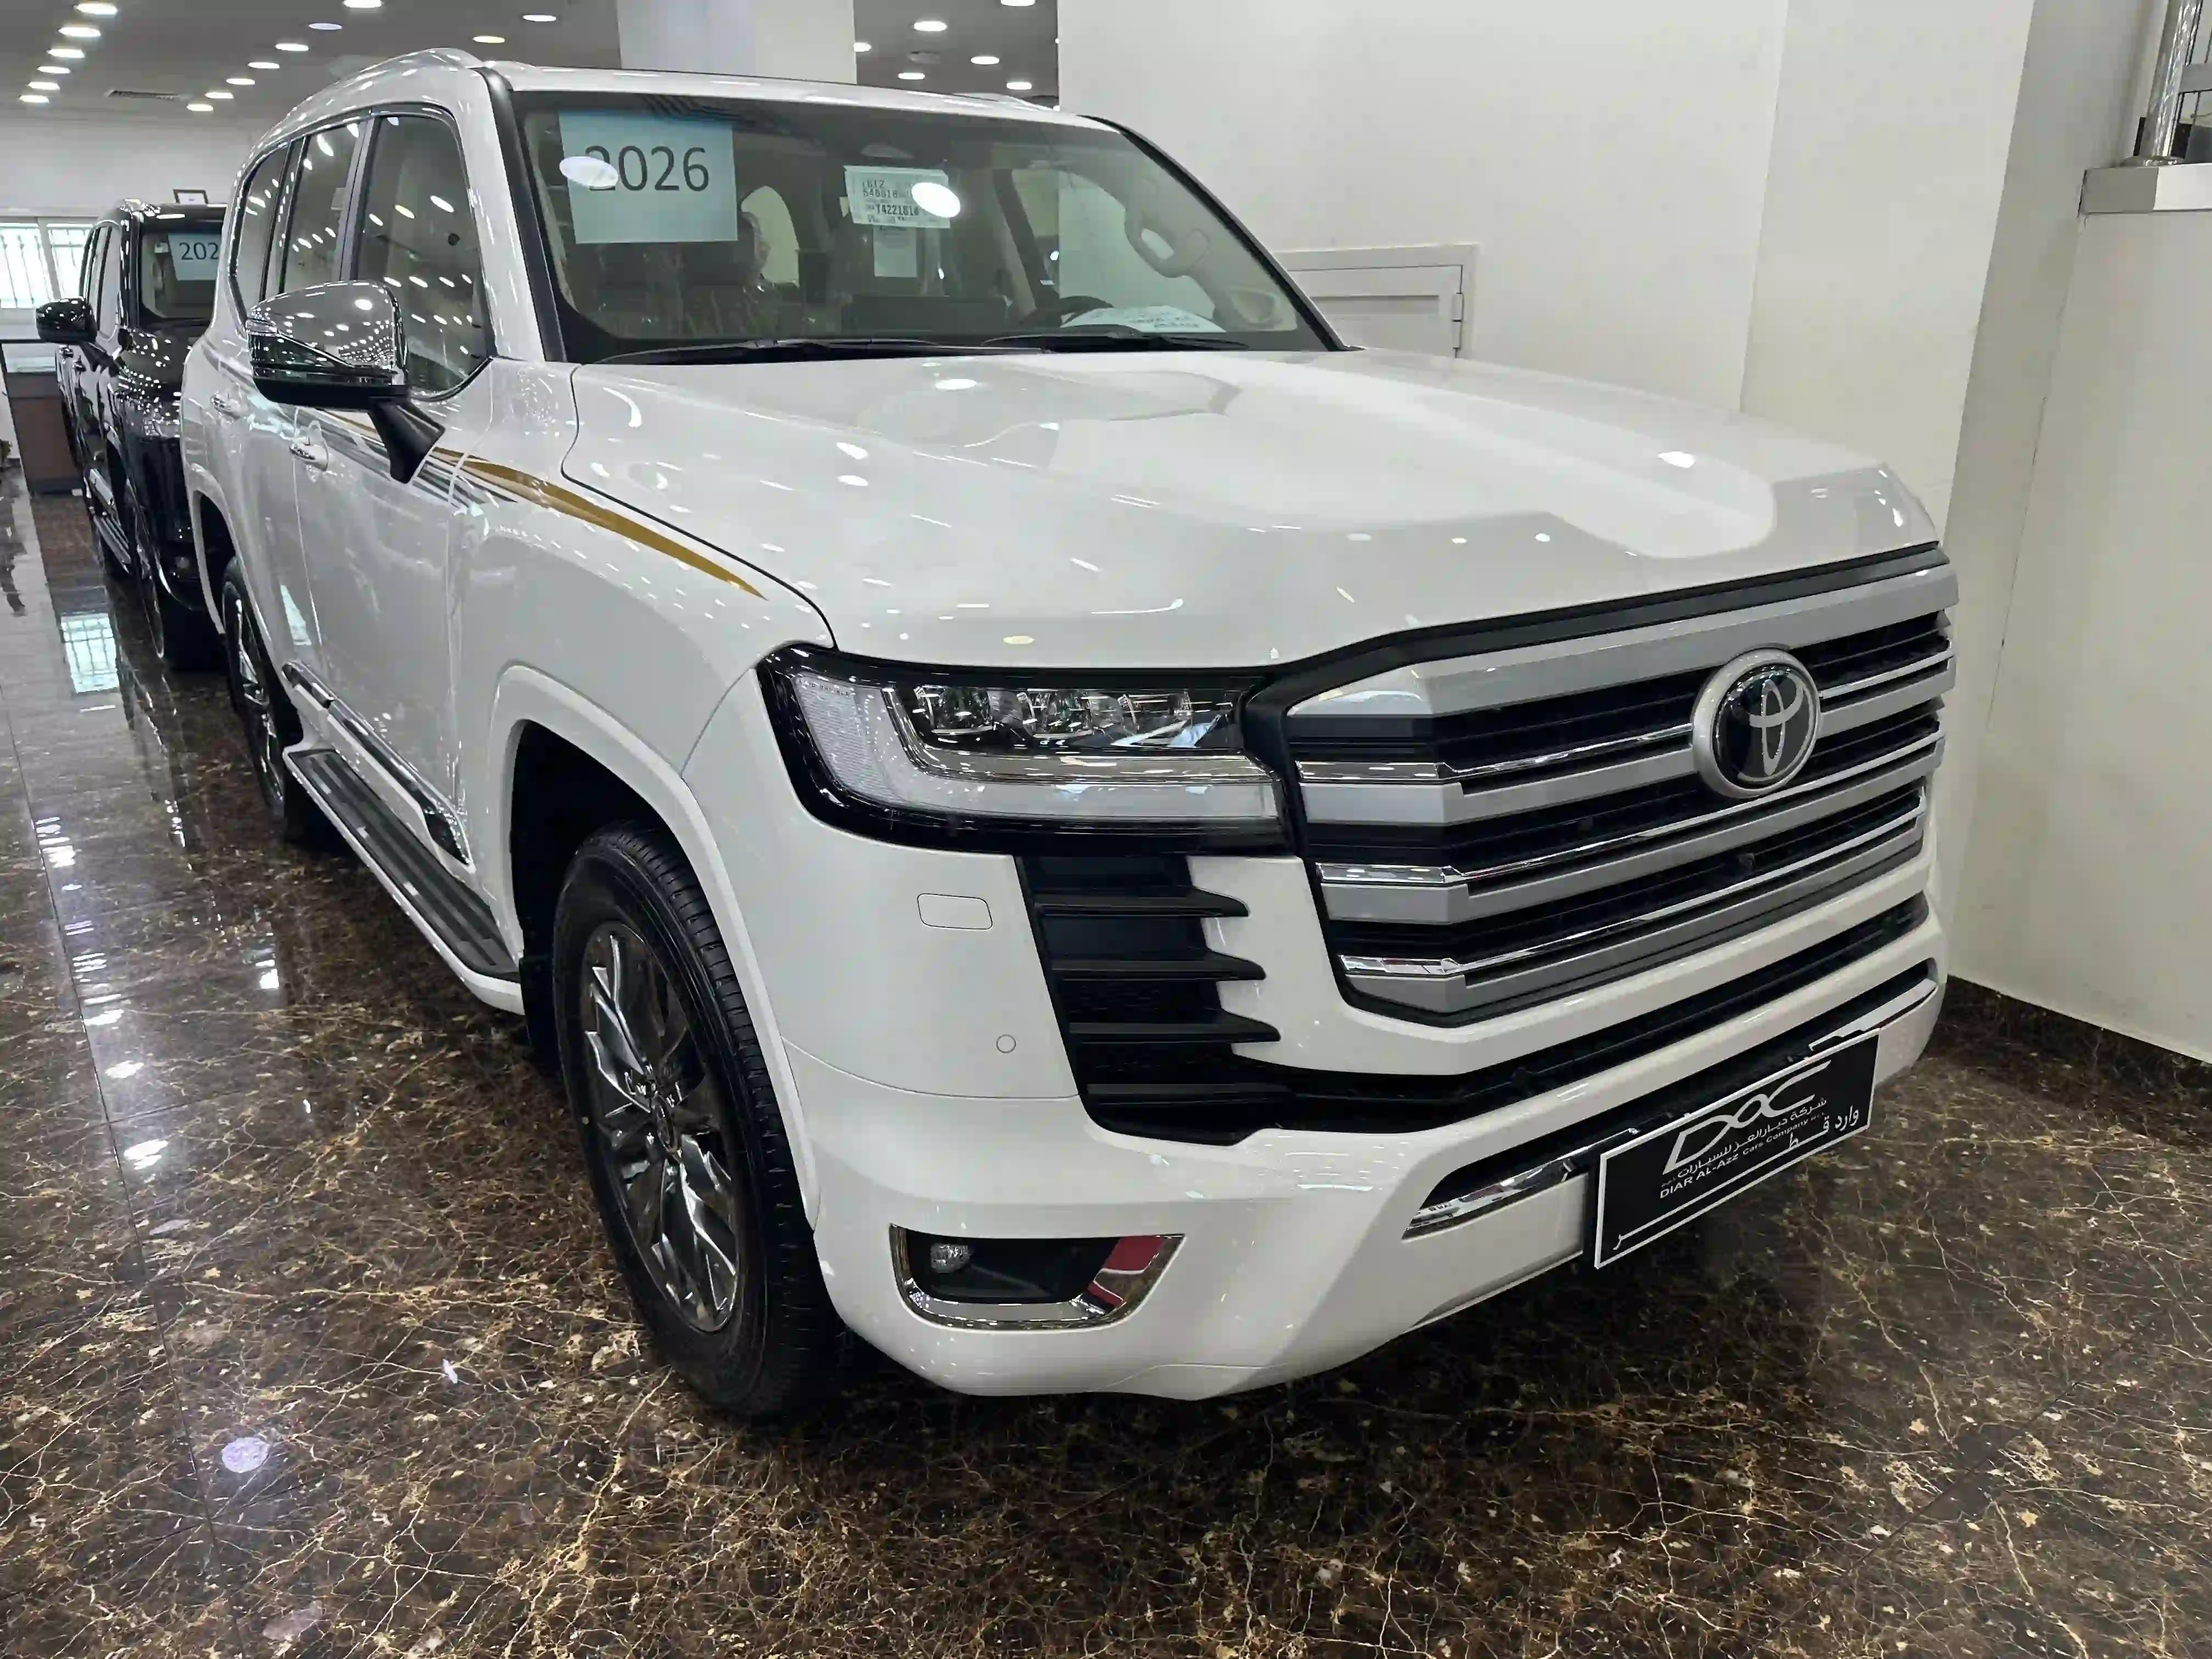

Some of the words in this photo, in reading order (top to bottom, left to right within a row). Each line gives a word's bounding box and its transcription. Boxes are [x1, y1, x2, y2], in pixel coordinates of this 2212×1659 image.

[585, 145, 709, 192] 2026
[1790, 1097, 1828, 1120] شركة
[1835, 1105, 1859, 1131] وارد
[1678, 1144, 1732, 1178] للسيارات
[1660, 1176, 1694, 1199] DIAR
